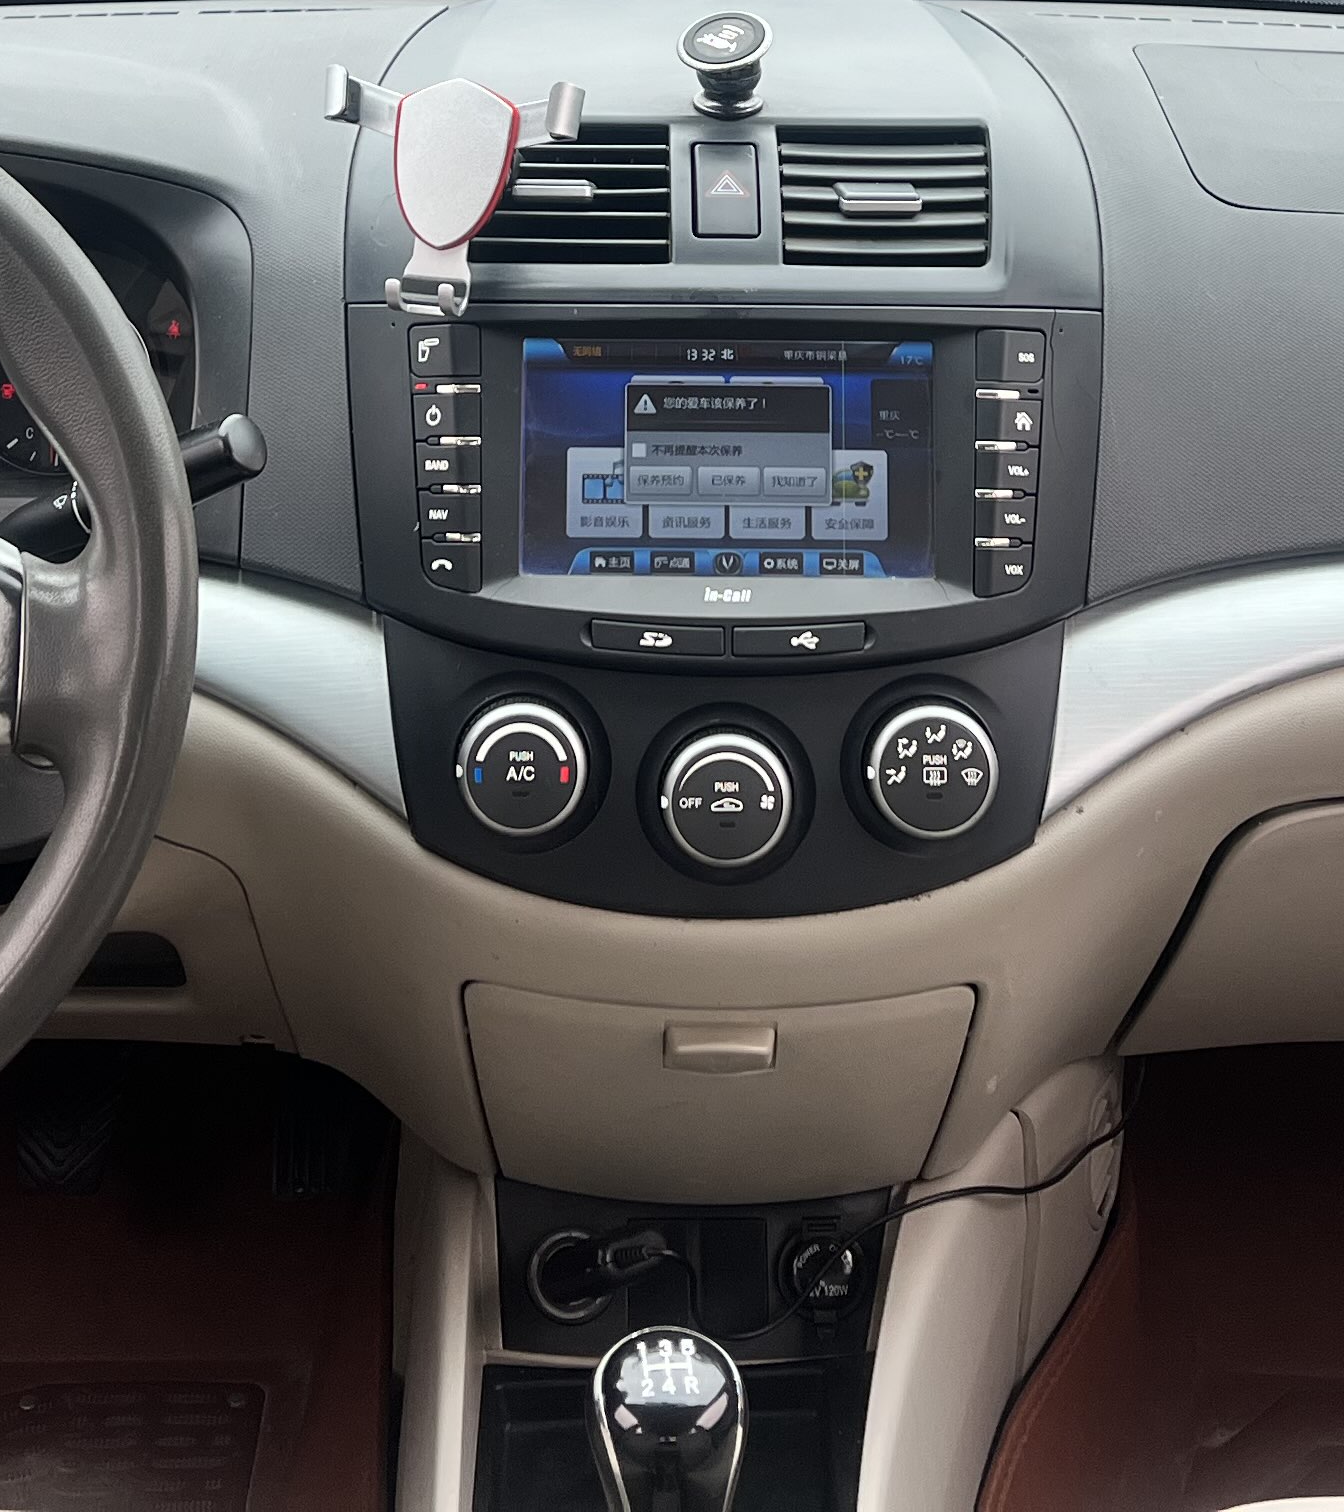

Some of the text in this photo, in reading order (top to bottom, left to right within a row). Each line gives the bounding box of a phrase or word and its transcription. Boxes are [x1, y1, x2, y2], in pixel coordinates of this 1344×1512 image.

[1018, 351, 1036, 363] SOS
[25, 427, 35, 439] C
[651, 444, 744, 457] 不再提醒本次保养
[424, 459, 450, 471] BAND
[428, 509, 449, 520] NAV
[580, 515, 630, 529] 影音娱乐
[662, 516, 712, 529] 资讯服务
[742, 516, 792, 530] 生活服务
[824, 518, 874, 531] 安全保障
[608, 556, 631, 569] 主页
[775, 558, 799, 570] 系统
[836, 558, 860, 571] 关屏
[1005, 564, 1024, 576] VOX
[509, 750, 534, 762] PUSH
[922, 754, 948, 766] PUSH
[505, 766, 536, 783] A/C
[714, 781, 739, 793] PUSH
[678, 797, 703, 810] OFF
[658, 1338, 673, 1357] 3
[680, 1338, 696, 1356] 5
[640, 1376, 700, 1398] 2 4 R
